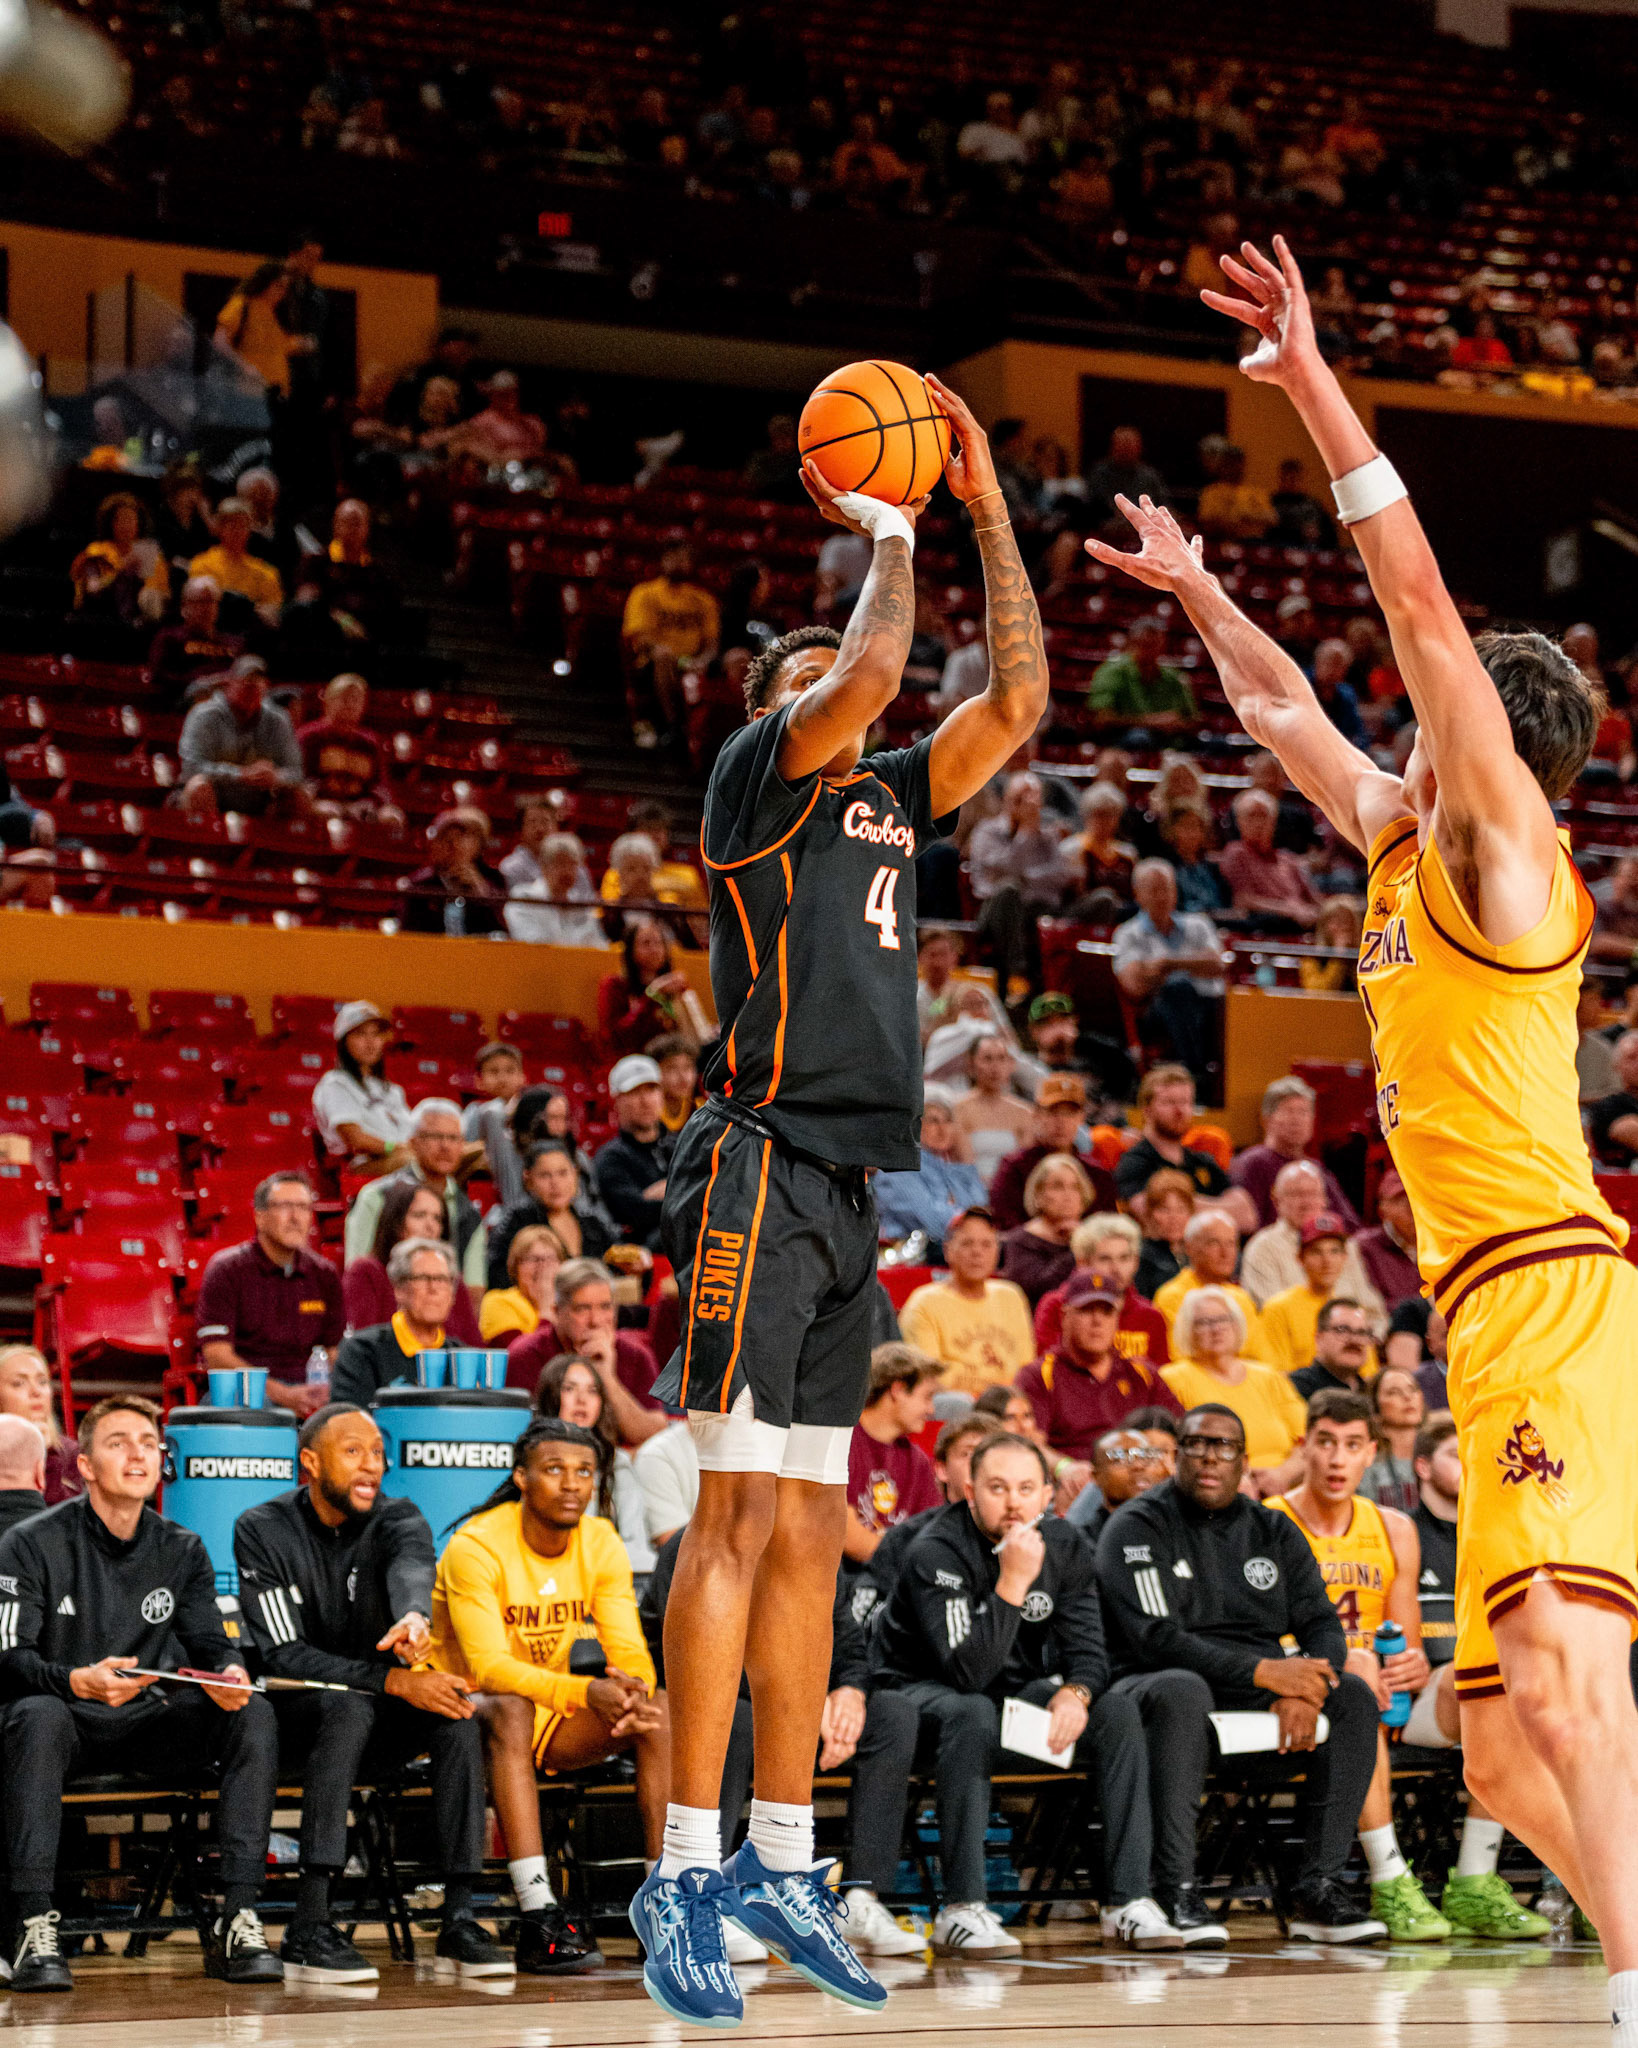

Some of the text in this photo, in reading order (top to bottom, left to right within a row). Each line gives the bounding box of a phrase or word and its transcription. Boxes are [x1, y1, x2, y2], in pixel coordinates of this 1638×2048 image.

[864, 865, 900, 950] 4
[697, 1229, 745, 1322] POKES
[189, 1457, 293, 1479] POWERADE
[406, 1442, 513, 1468] POWERA
